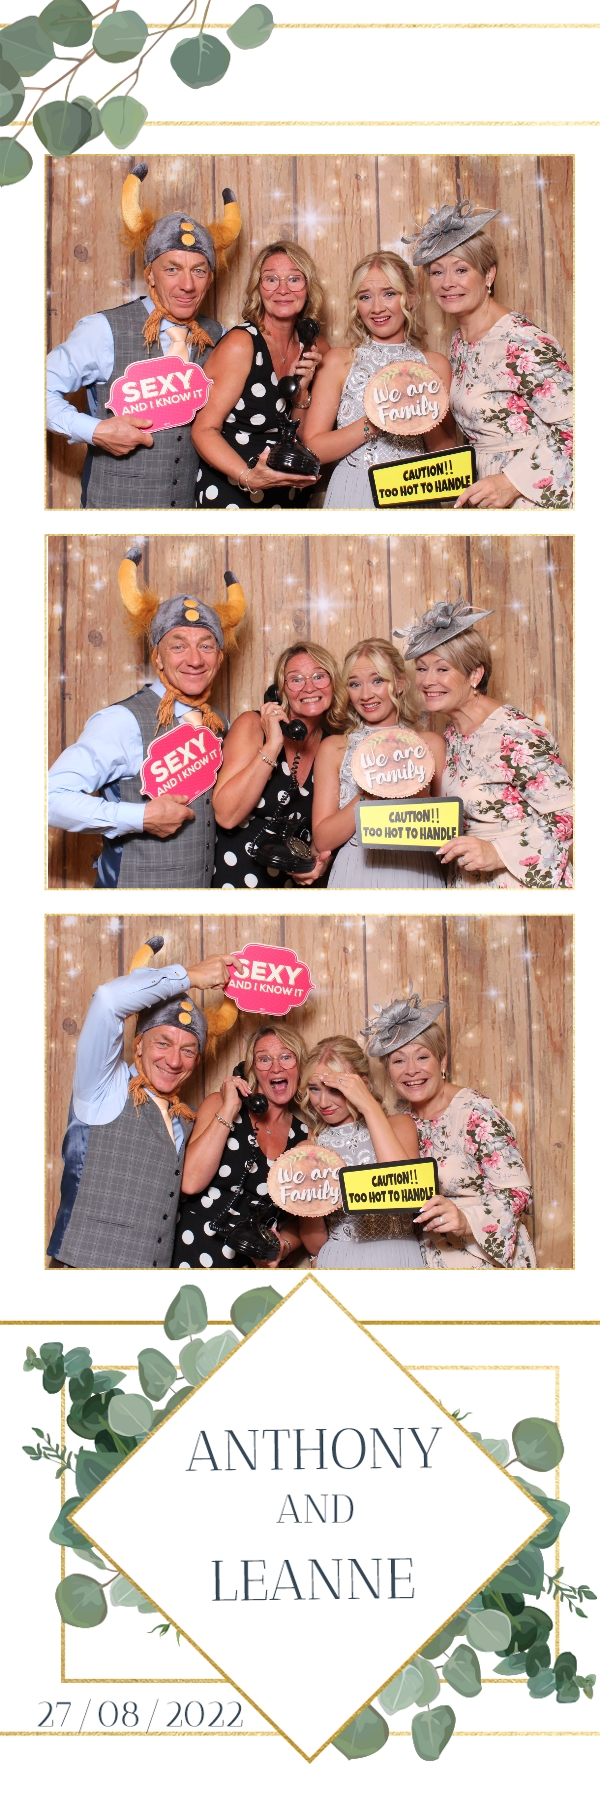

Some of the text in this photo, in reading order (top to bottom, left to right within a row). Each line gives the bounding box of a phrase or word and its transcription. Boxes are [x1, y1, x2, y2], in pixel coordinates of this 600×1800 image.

[121, 369, 194, 403] SEXY
[373, 380, 440, 404] We are
[122, 389, 203, 415] AND I KNOW IT
[376, 395, 439, 425] Family
[403, 459, 454, 482] CAUTION!!
[379, 475, 471, 498] TOO HOT TO HANDLE
[150, 732, 206, 783] SEXY
[360, 745, 426, 769] We are
[157, 777, 178, 797] AND
[181, 755, 209, 779] KNOW
[209, 749, 218, 760] IT
[364, 759, 425, 789] Family
[389, 808, 440, 823] CAUTION!!
[363, 827, 457, 840] TOO HOT TO HANDLE
[233, 958, 303, 986] SEXY
[228, 979, 304, 997] AND I KNOW IT
[278, 1162, 305, 1184] We
[371, 1169, 419, 1187] CAUTION!!
[279, 1181, 340, 1205] Family
[349, 1187, 434, 1203] TOO HOT TO HANDLE
